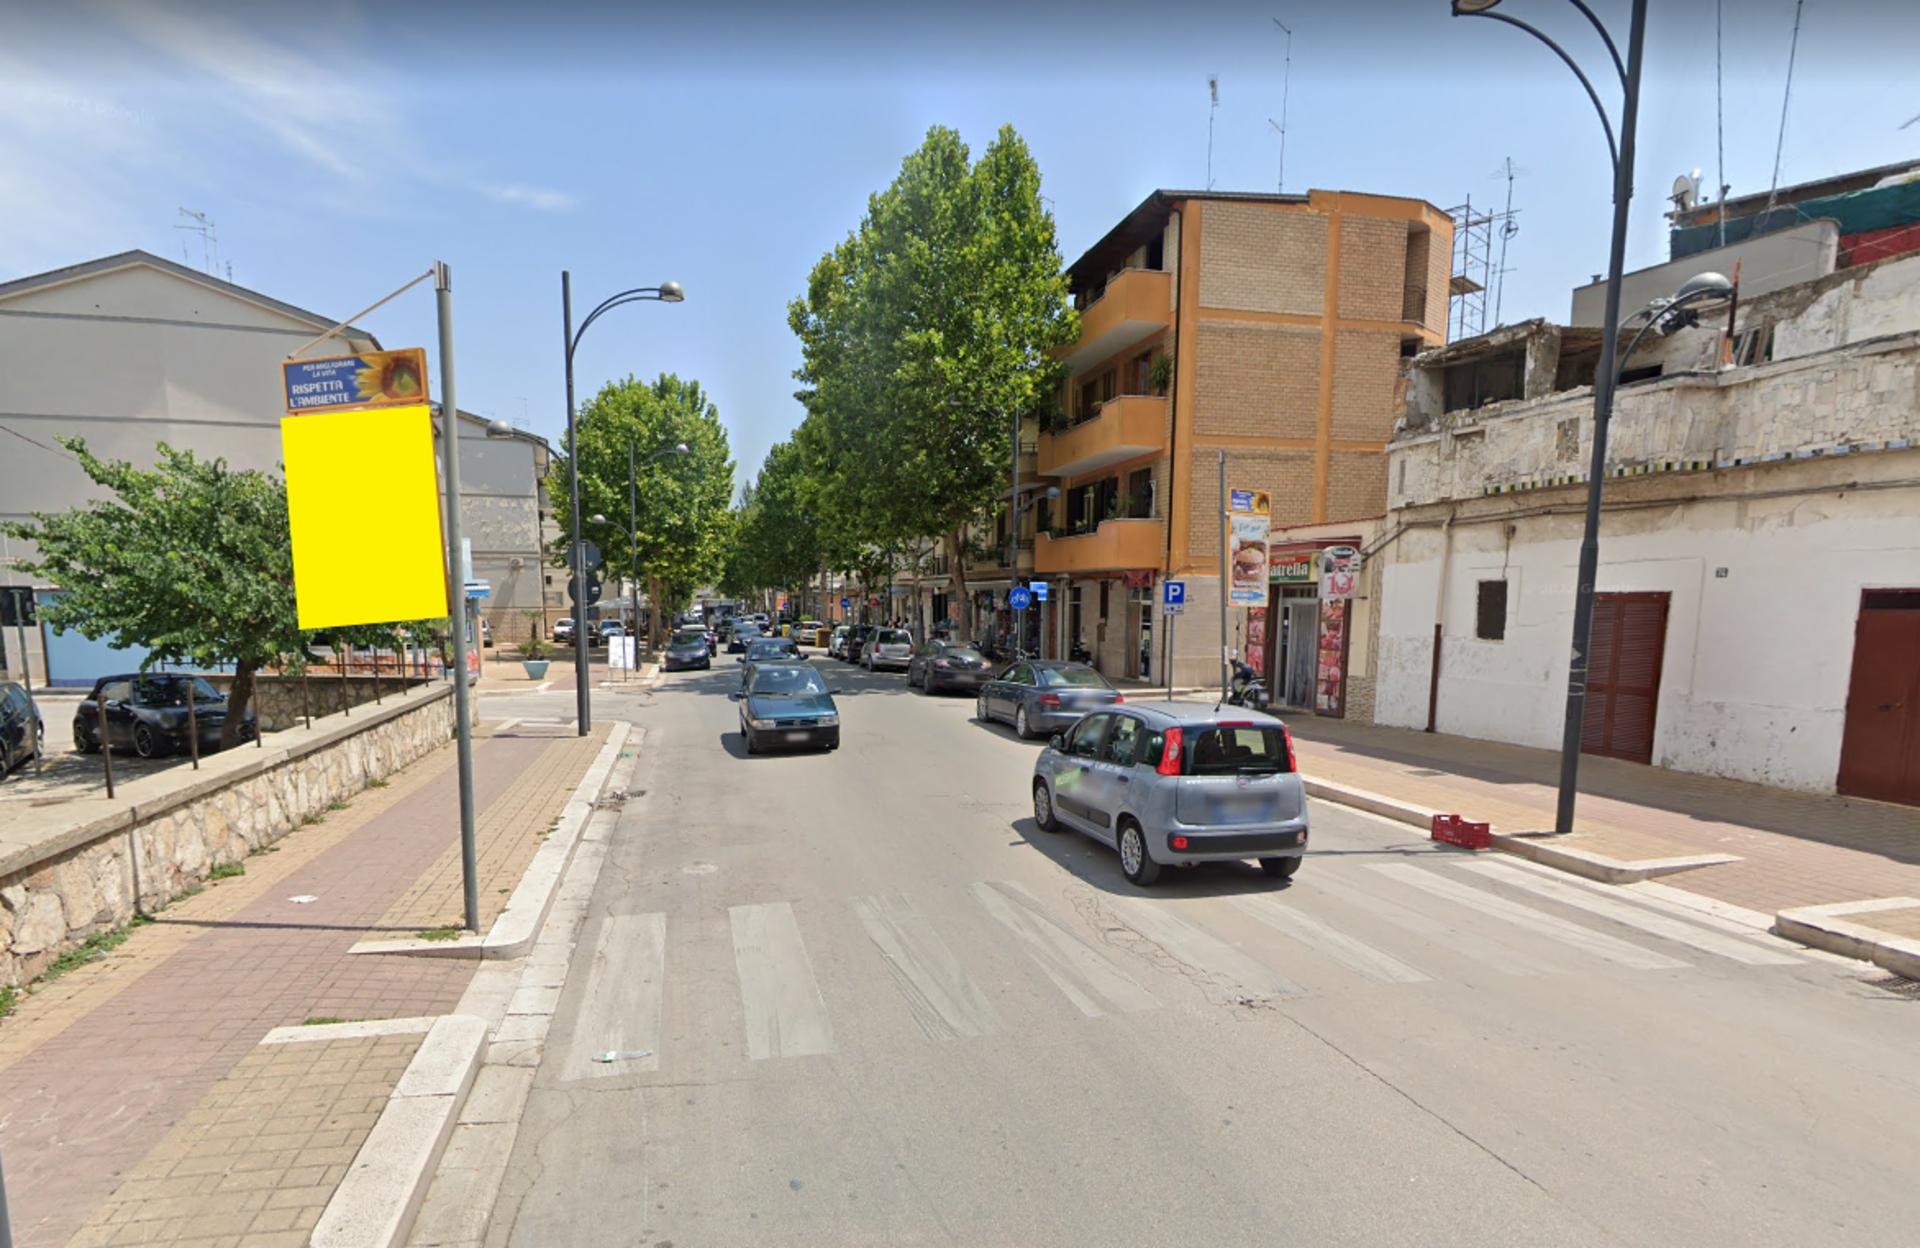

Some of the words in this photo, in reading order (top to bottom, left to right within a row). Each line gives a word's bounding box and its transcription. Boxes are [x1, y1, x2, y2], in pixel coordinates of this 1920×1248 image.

[316, 360, 355, 369] MIGLIORARE
[312, 370, 320, 378] LA
[321, 368, 336, 377] VITA
[292, 380, 343, 395] RISPETTA
[290, 392, 350, 407] L'AMBIENTE
[1168, 584, 1182, 602] P
